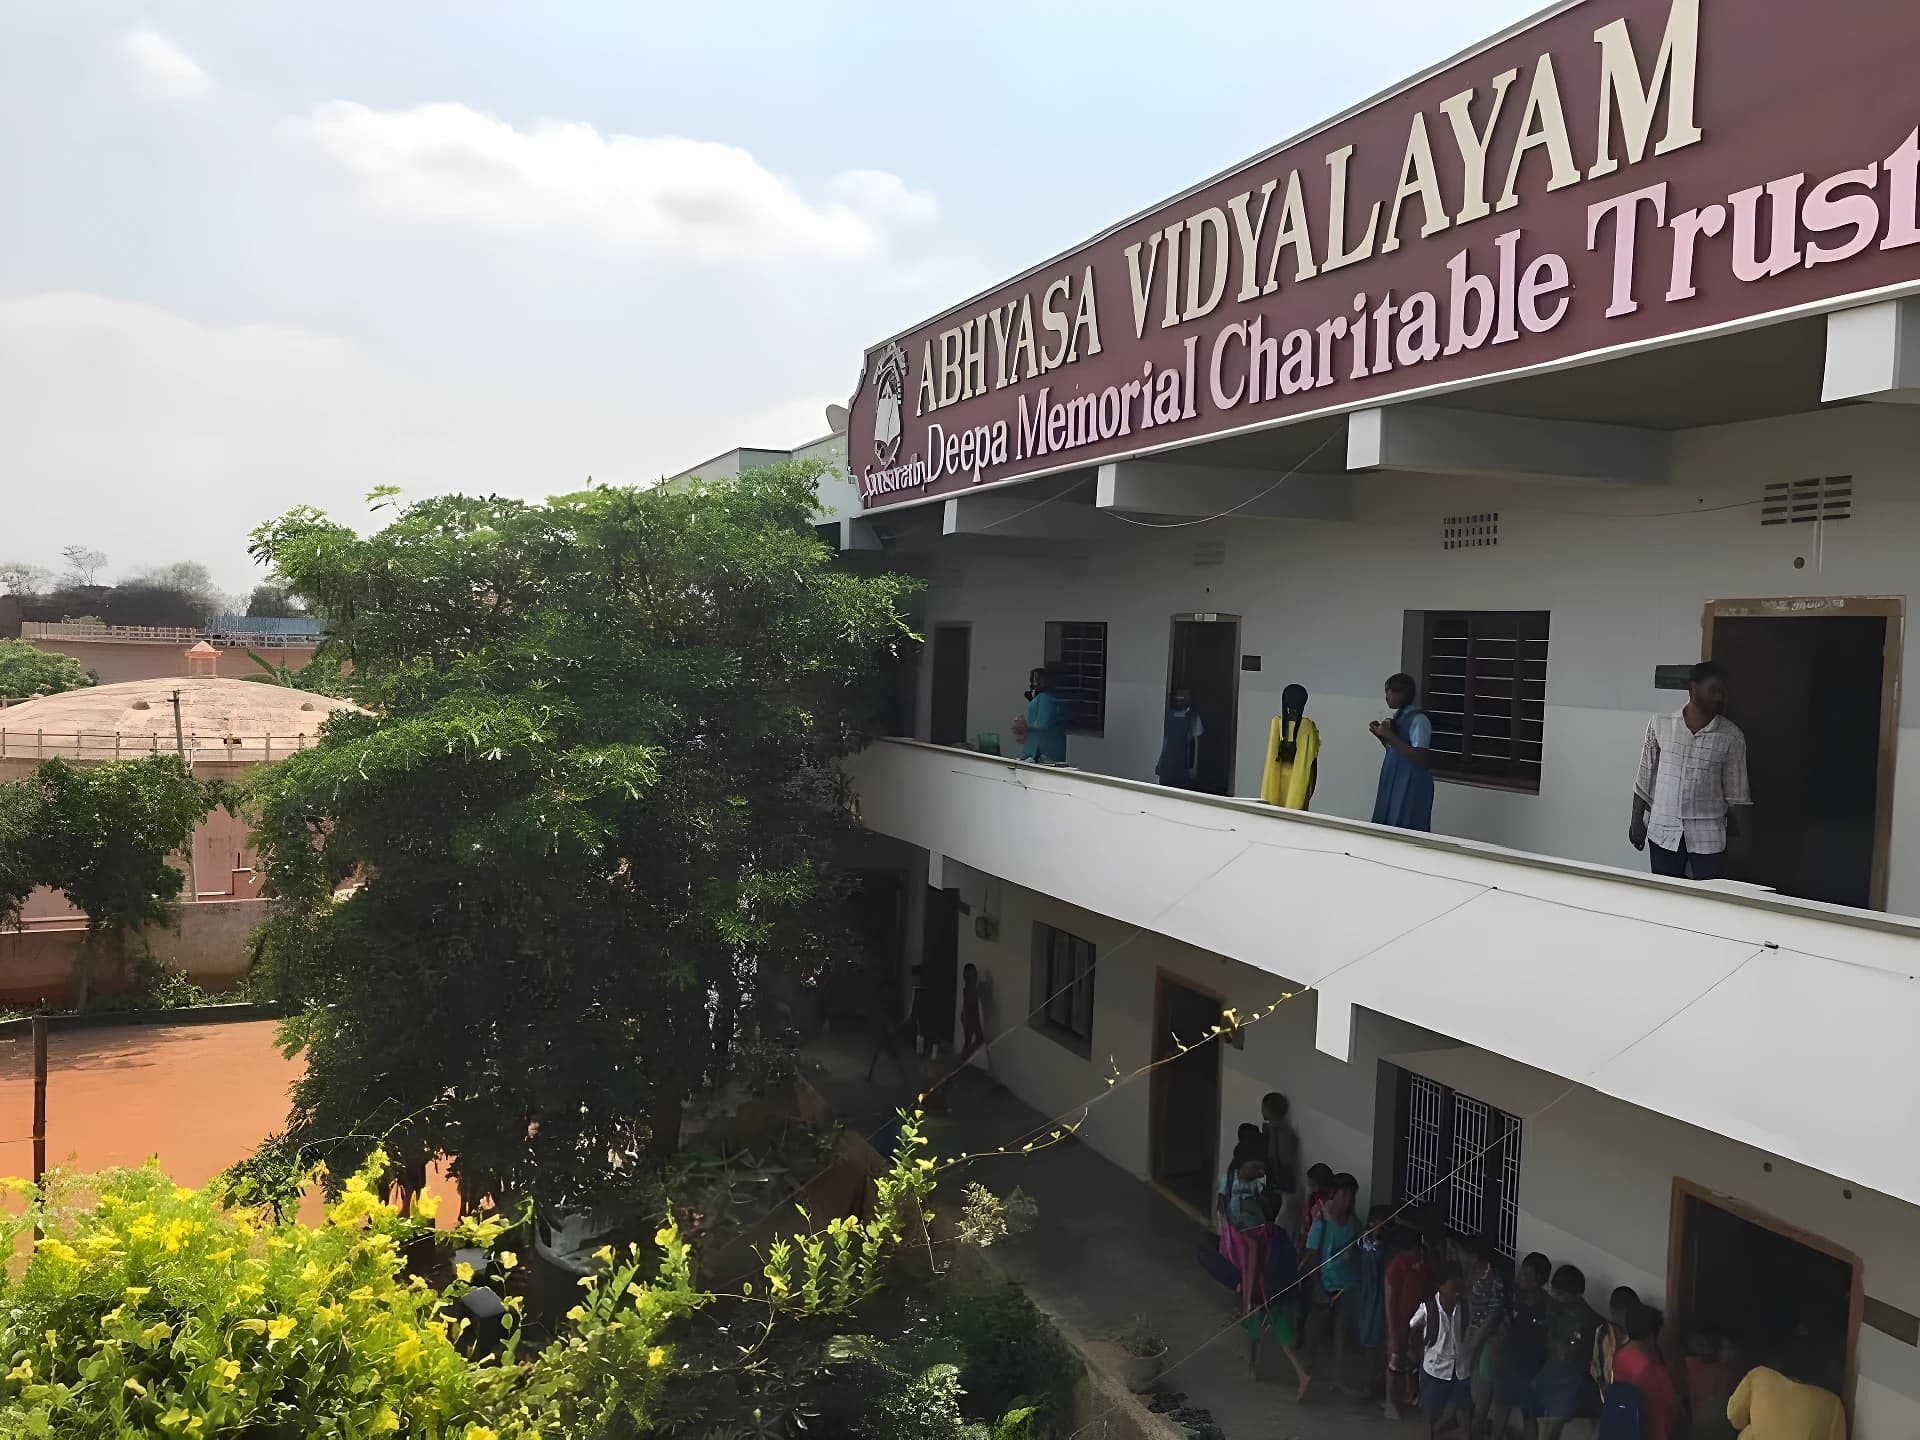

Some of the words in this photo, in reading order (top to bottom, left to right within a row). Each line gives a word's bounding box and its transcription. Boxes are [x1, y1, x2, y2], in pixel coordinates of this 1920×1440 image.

[916, 264, 1102, 417] ABHYASA
[1124, 0, 1703, 339] VIDYALAYAM
[927, 421, 1008, 483] Deepa
[1015, 335, 1199, 461] Memorial
[1209, 229, 1570, 410] Charitable
